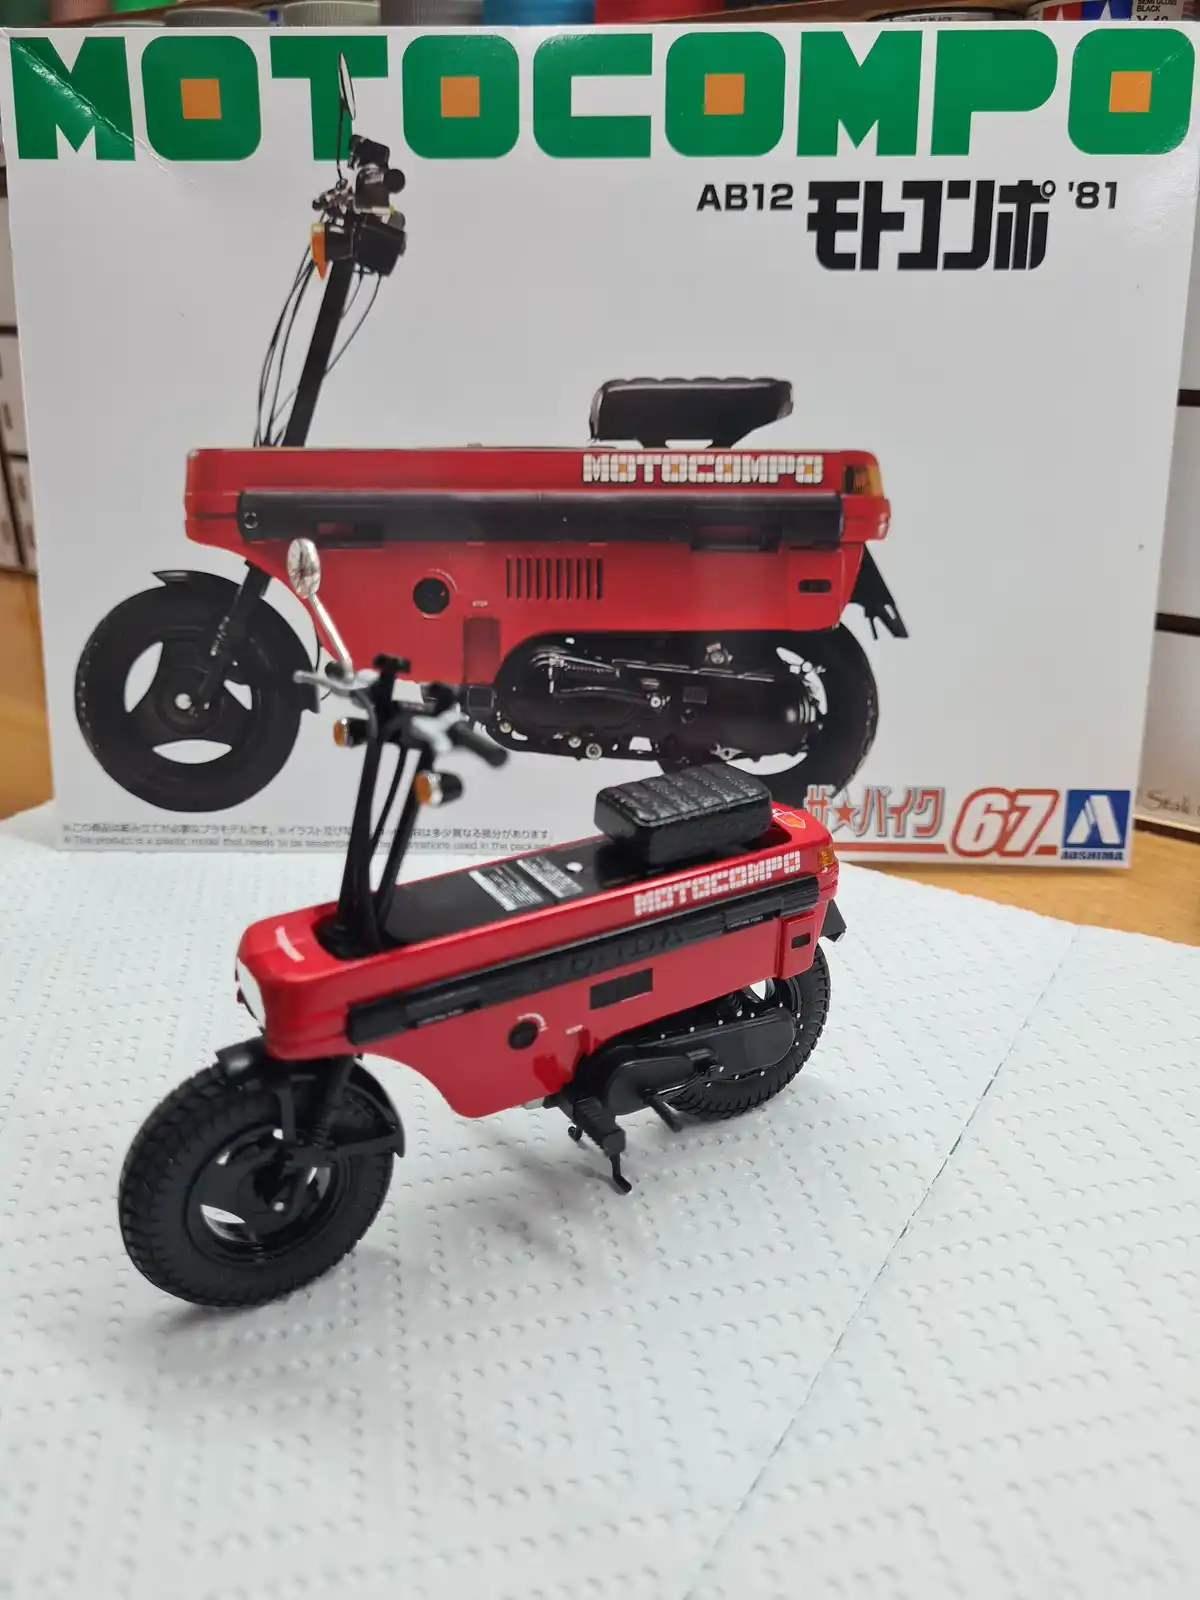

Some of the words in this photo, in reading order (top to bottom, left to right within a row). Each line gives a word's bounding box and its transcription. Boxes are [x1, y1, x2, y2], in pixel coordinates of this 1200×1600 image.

[10, 29, 1195, 161] MOTOCOMPO
[697, 183, 794, 211] AB12
[807, 180, 1056, 271] モトコンポ
[1068, 182, 1118, 209] '81
[582, 453, 824, 484] MOTOCOMPO
[952, 787, 1060, 858] 67
[1061, 851, 1123, 861] AOSHIMA
[634, 850, 800, 916] MOTOCOMPO
